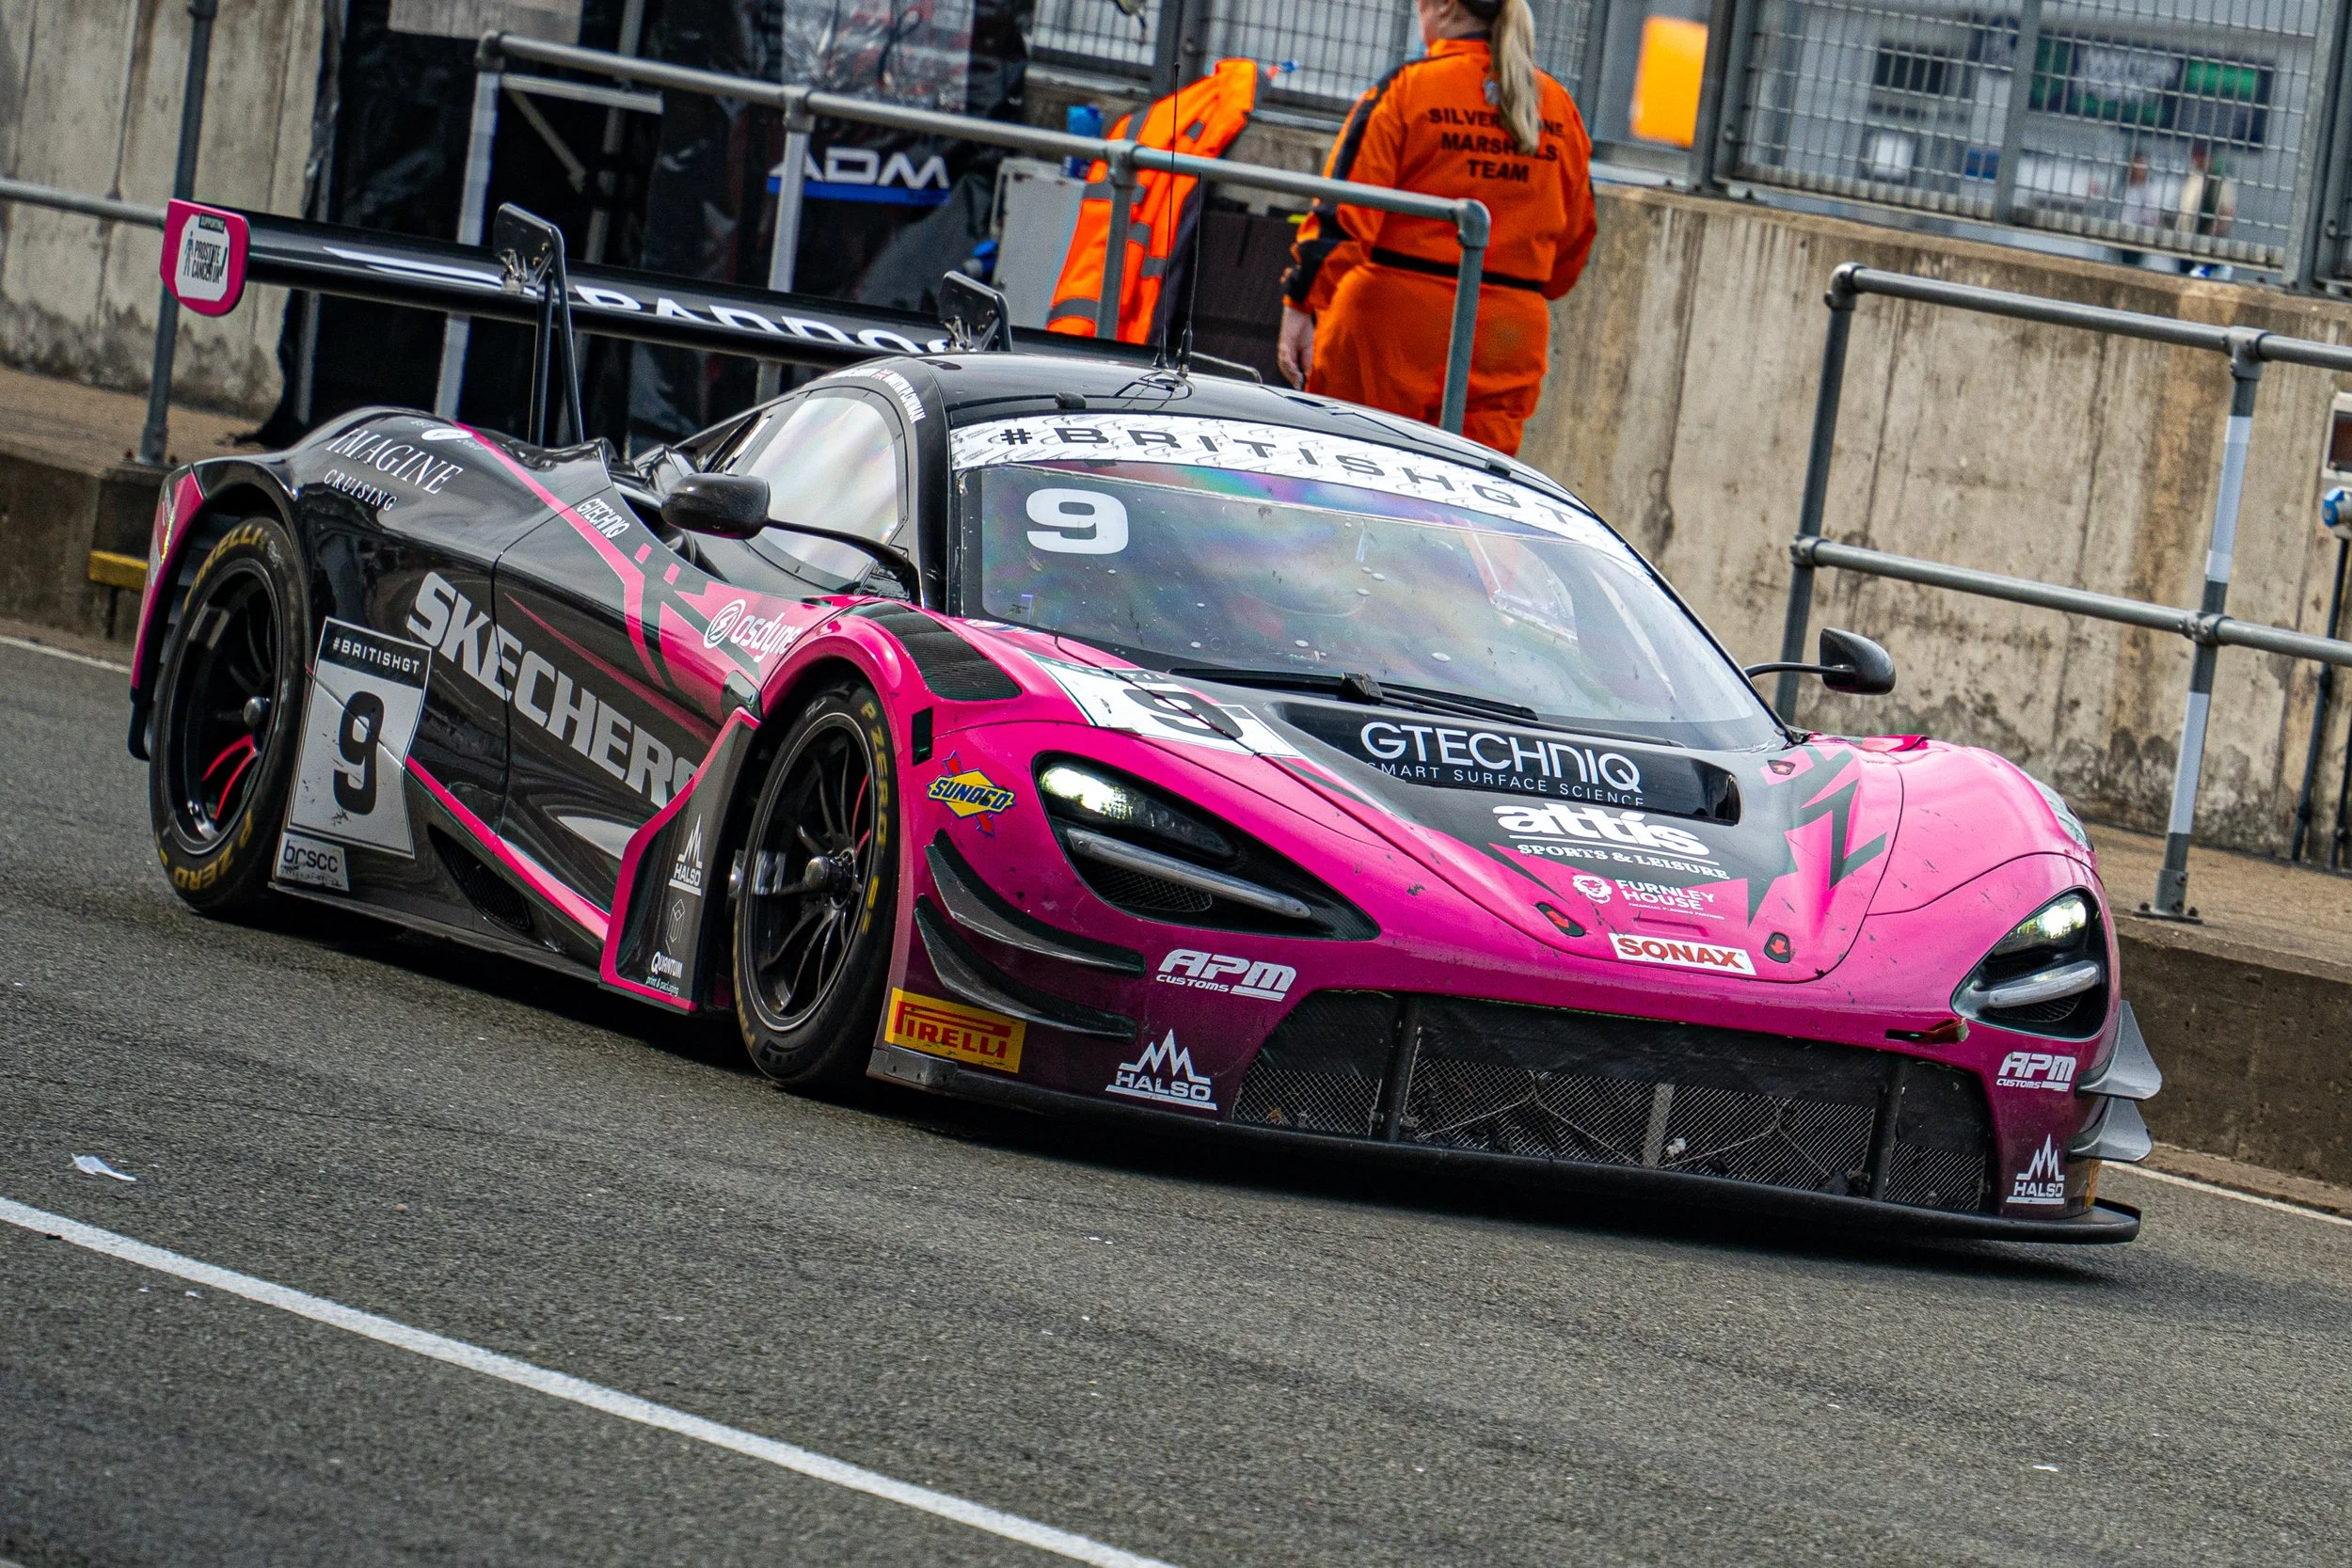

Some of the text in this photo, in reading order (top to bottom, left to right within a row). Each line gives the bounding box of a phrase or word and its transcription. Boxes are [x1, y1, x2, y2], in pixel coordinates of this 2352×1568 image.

[1441, 132, 1558, 162] MARSHS
[1468, 160, 1529, 182] TEAM
[326, 428, 464, 495] IMAGINE
[999, 427, 1573, 525] #BRITISHGT
[324, 469, 398, 512] CRUISING
[577, 498, 630, 539] GTECHNIQ
[1025, 488, 1129, 555] 9
[332, 636, 421, 675] #BRITISHGT
[1122, 689, 1244, 741] 9
[333, 690, 385, 816] 9
[1360, 721, 1643, 794] GTECHNIQ
[870, 725, 889, 847] ZERO
[930, 779, 1011, 810] SUNOCO
[1367, 762, 1645, 807] SMART SURFACE SCIENCE
[1492, 802, 1710, 857] attis
[283, 839, 340, 874] brscc
[674, 863, 702, 887] HALSO
[1517, 844, 1731, 880] SPORTS & LEISURE
[1614, 879, 1716, 904] FURNLEY
[1621, 890, 1704, 911] HOUSE
[1158, 948, 1297, 992] APM
[1617, 937, 1745, 970] SONAX
[1155, 974, 1230, 993] CUSTOMS
[895, 1001, 1012, 1059] PIRELLI
[1115, 1069, 1212, 1101] HALSO
[1995, 1078, 2042, 1089] CUSTOMS
[1997, 1051, 2077, 1082] APM
[2013, 1181, 2064, 1197] HALSO
